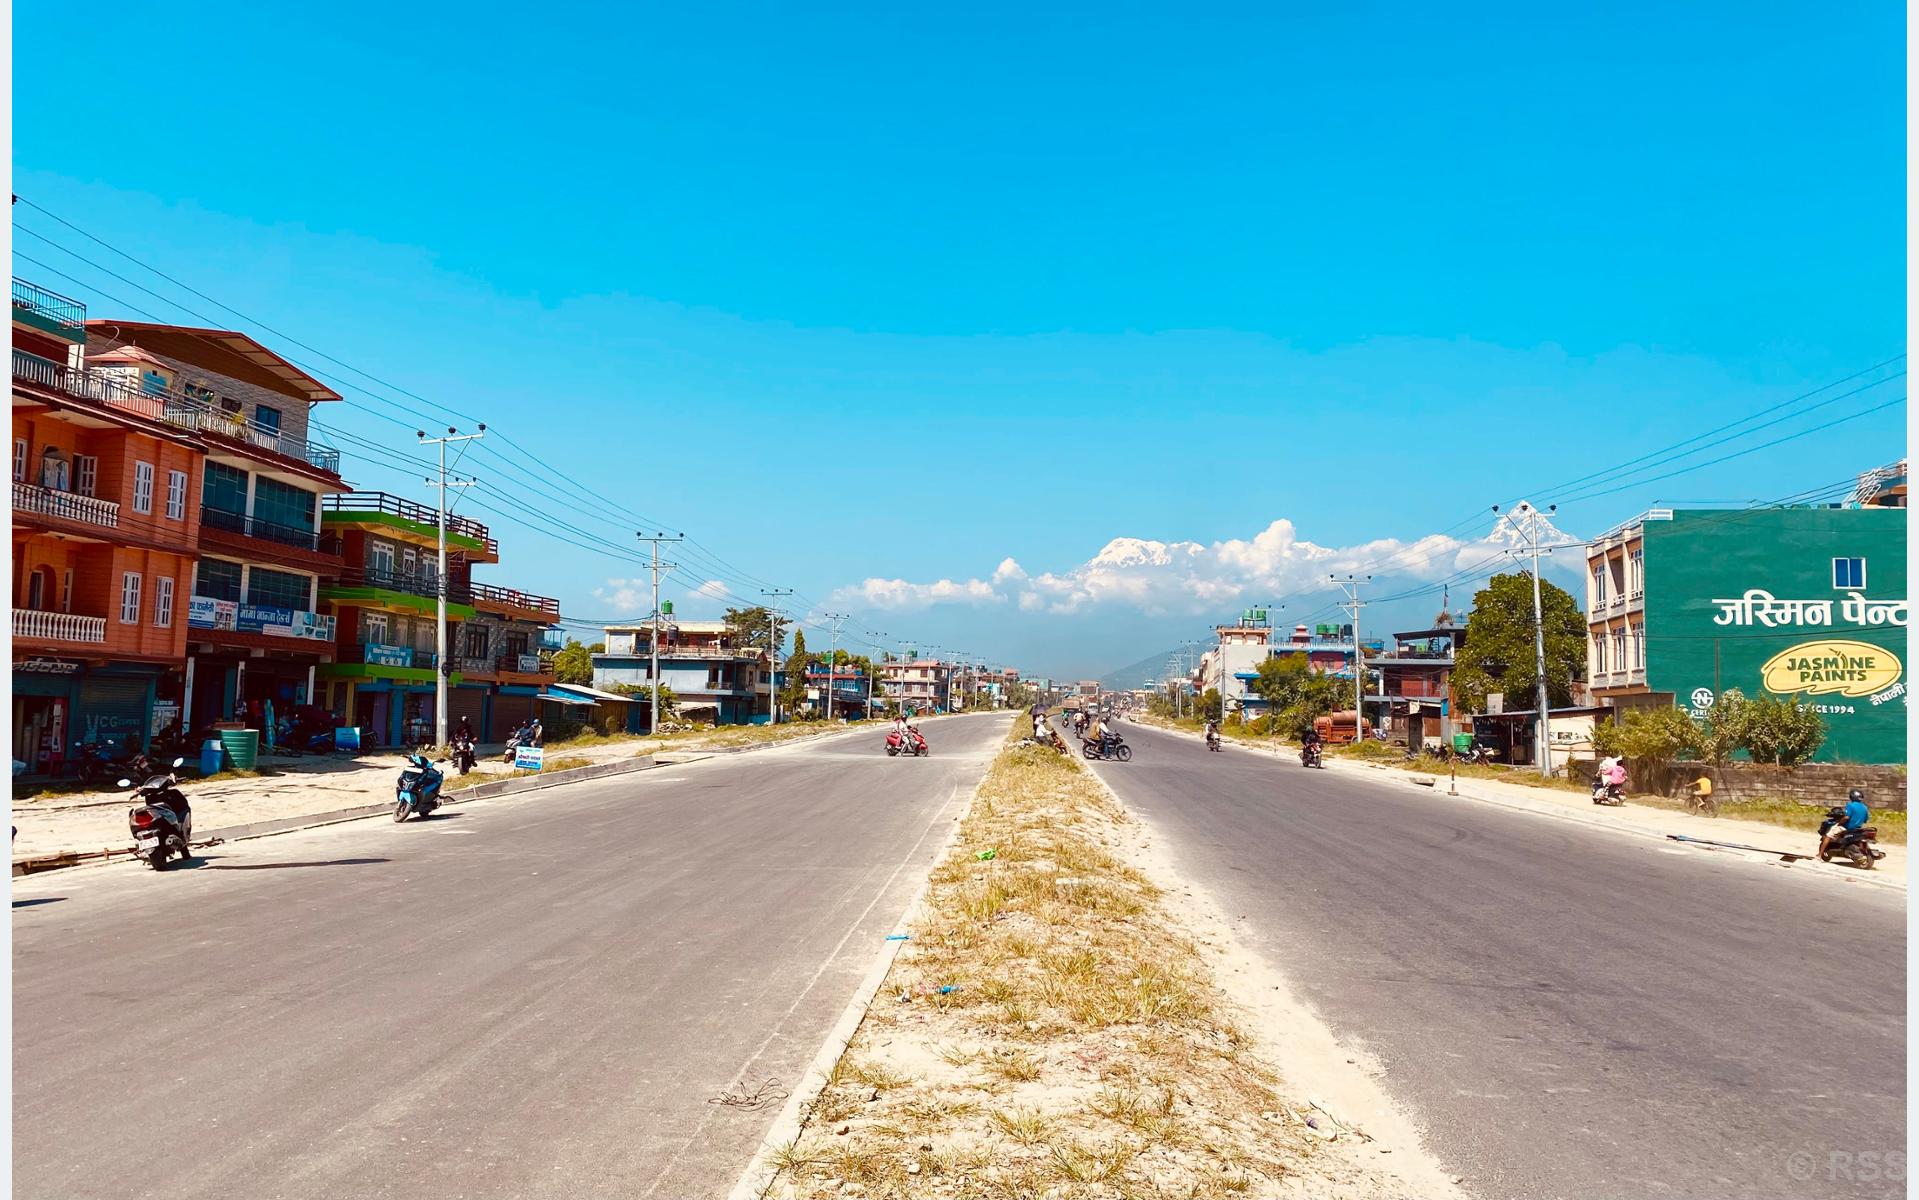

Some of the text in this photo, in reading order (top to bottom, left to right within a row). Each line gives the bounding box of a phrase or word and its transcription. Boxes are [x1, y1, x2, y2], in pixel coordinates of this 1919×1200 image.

[1711, 589, 1834, 627] जस्मिन
[1787, 656, 1875, 670] JASMINE
[1800, 669, 1867, 682] PAINTS
[1869, 682, 1906, 706] नेपाली
[1829, 705, 1855, 714] 1994
